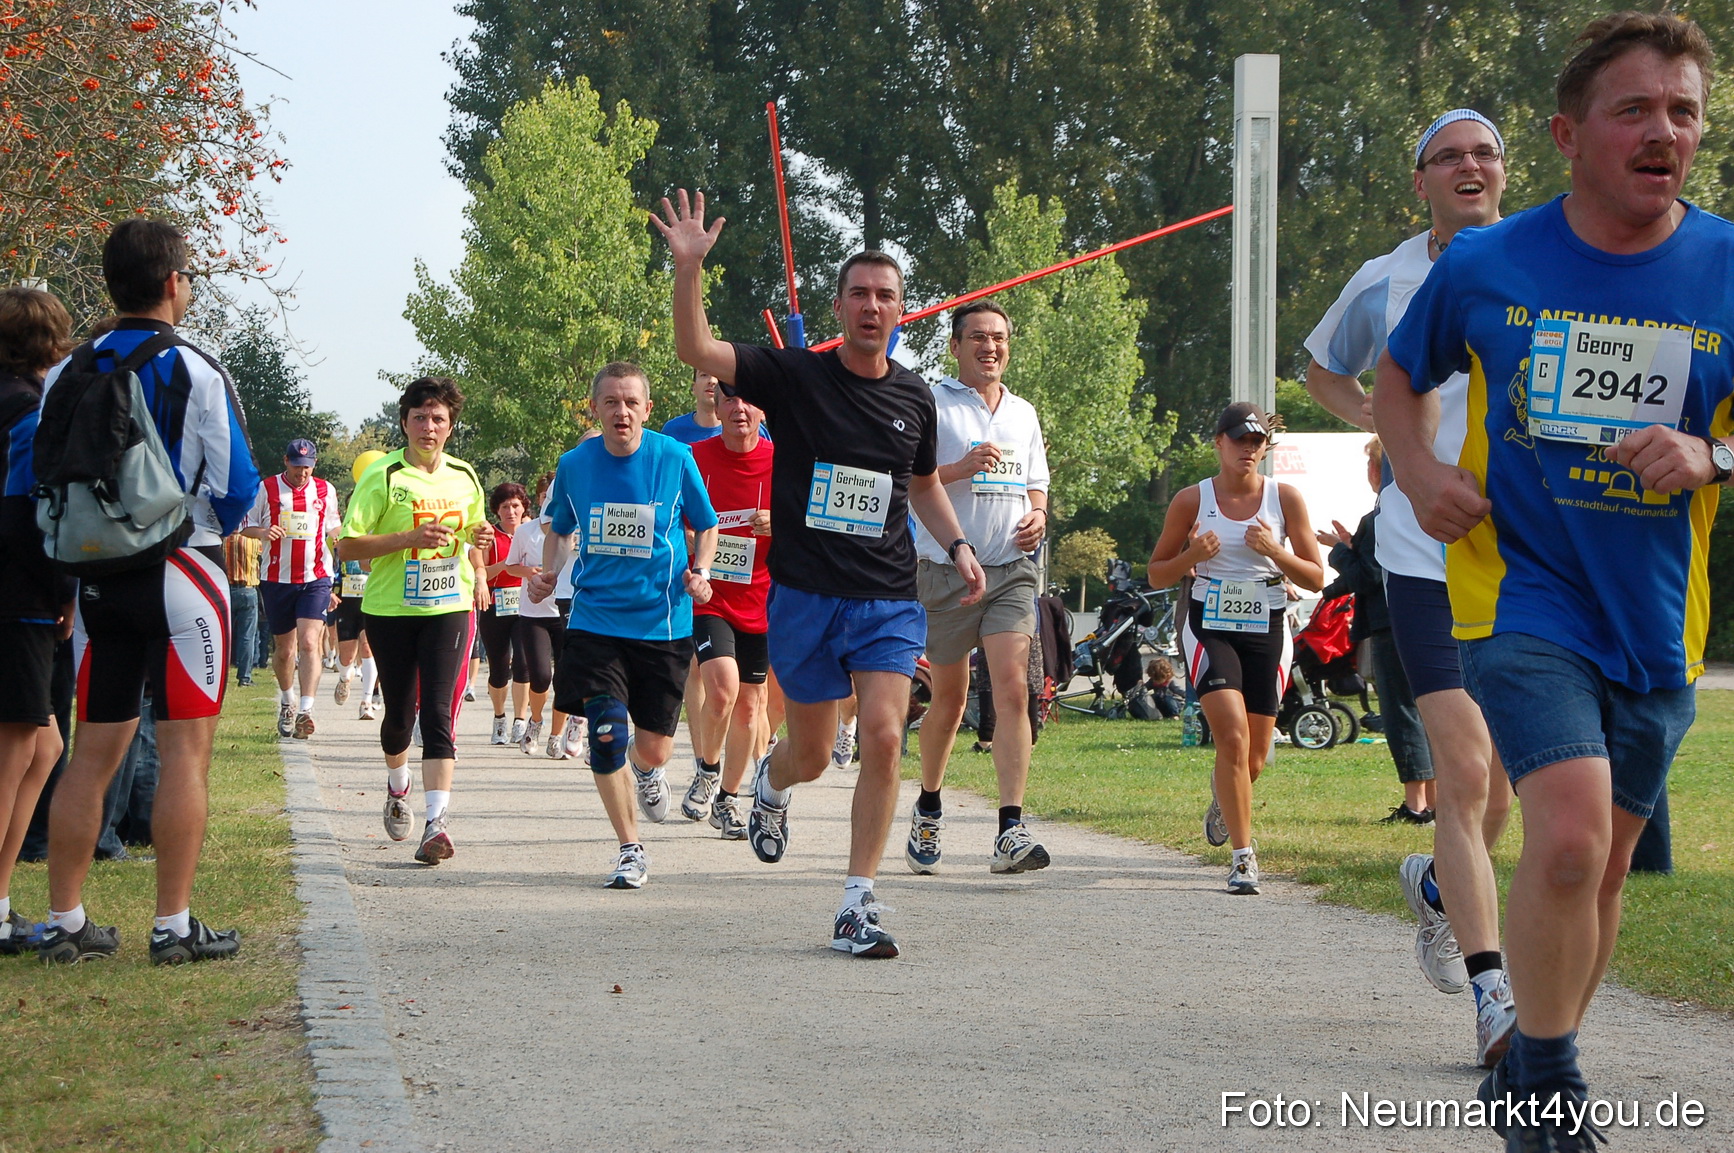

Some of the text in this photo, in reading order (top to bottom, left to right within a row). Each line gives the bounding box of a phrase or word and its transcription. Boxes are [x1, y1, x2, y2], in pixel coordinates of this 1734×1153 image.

[1505, 306, 1532, 327] 10.
[1576, 332, 1634, 362] Georg
[1539, 362, 1549, 378] C
[1571, 368, 1668, 406] 2942
[991, 461, 1022, 476] 3378
[836, 471, 875, 489] Gerhard
[815, 486, 822, 496] D
[833, 491, 880, 513] 3153
[607, 507, 637, 519] Michael
[297, 522, 308, 531] 20
[607, 523, 646, 539] 2828
[713, 551, 747, 567] 2529
[422, 562, 455, 573] Rosmarie
[407, 577, 412, 585] C
[422, 575, 455, 592] 2080
[1223, 585, 1242, 595] Julia
[1223, 600, 1262, 614] 2328
